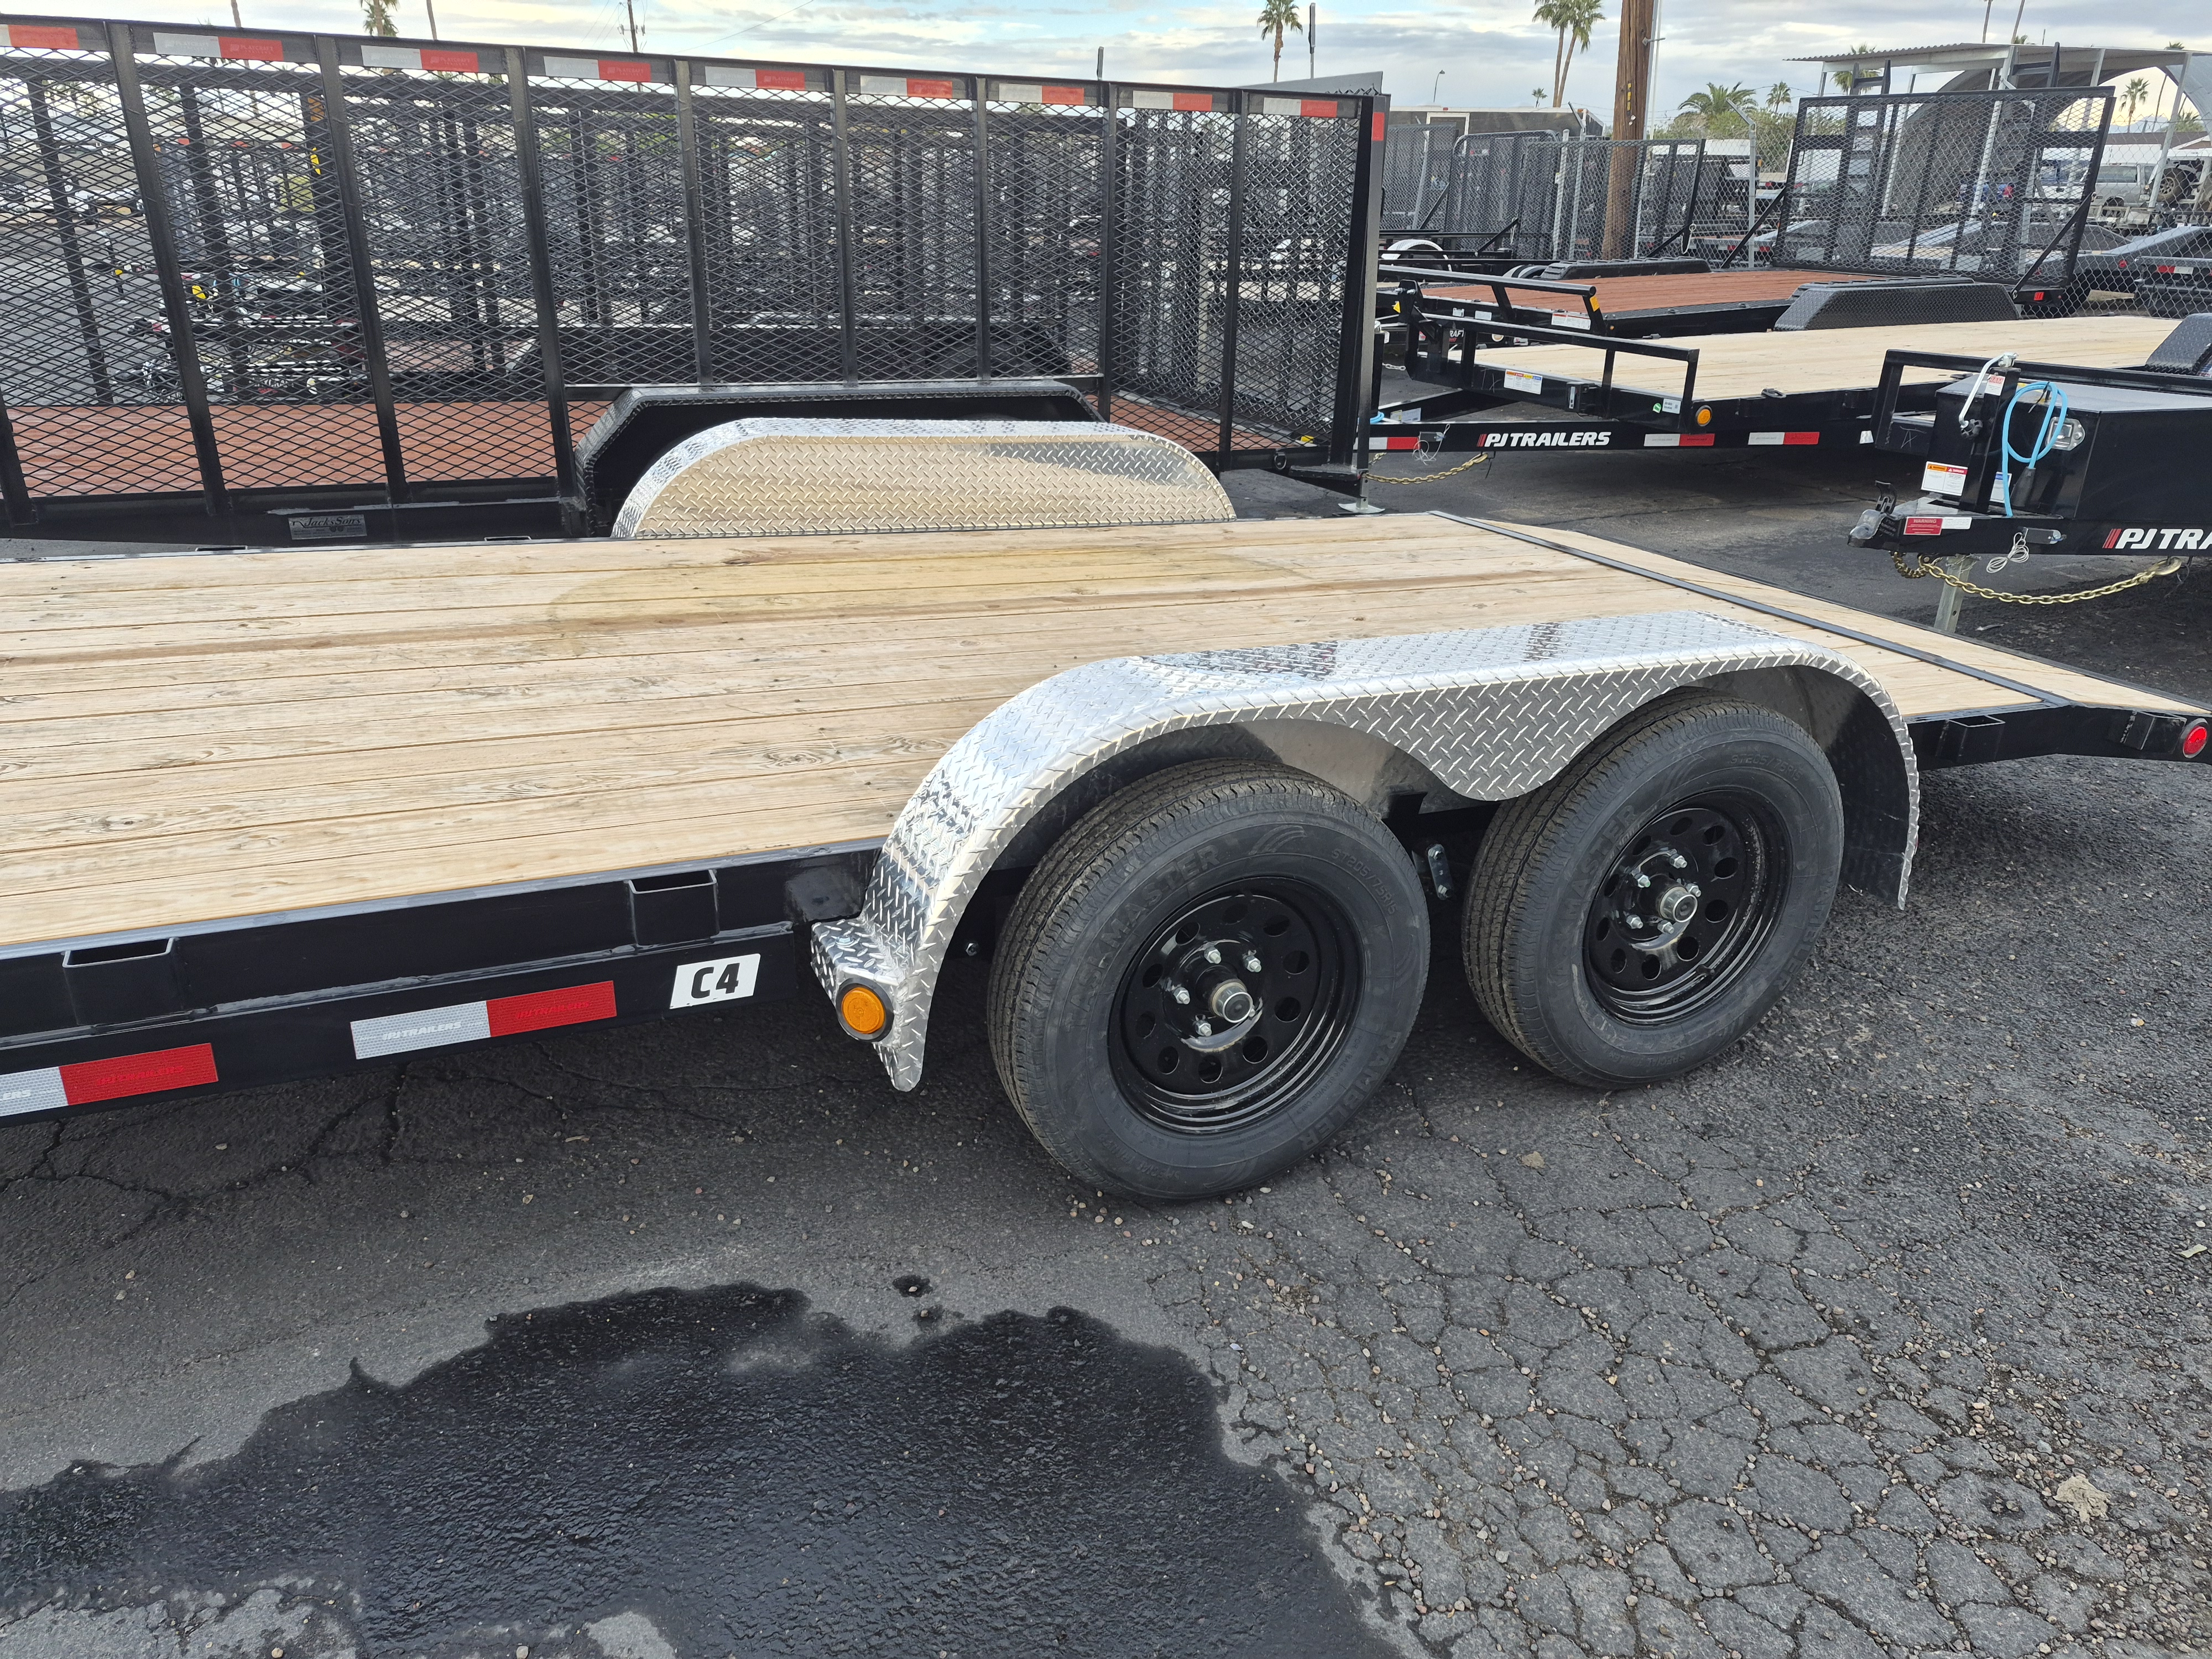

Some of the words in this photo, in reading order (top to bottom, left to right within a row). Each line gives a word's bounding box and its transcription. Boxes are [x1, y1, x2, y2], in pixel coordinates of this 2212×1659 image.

[1510, 432, 1612, 447] TRAILERS
[1332, 848, 1398, 915] ST205/75R15
[1065, 844, 1220, 1032] TASKMASTER
[691, 963, 740, 999] C4
[401, 1021, 461, 1037] TRAILERS
[0, 1089, 31, 1100] ERS
[1298, 1030, 1402, 1151] RAMBLER
